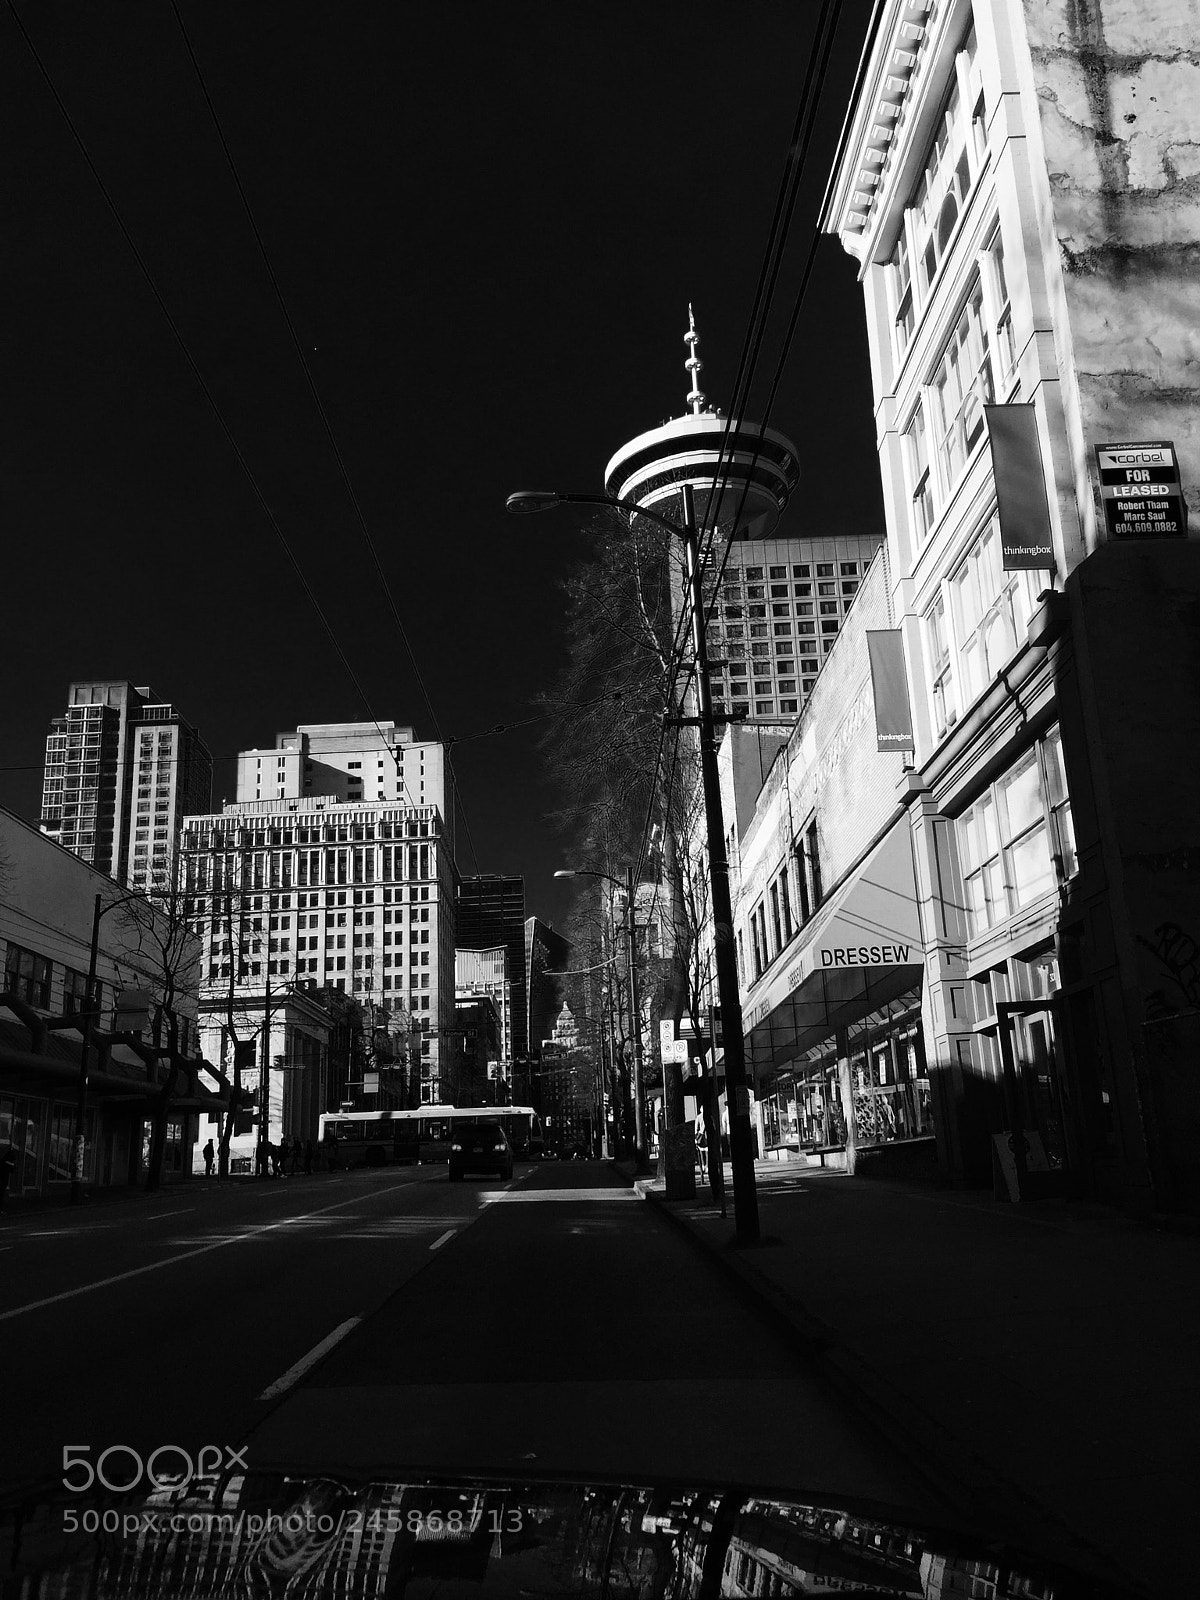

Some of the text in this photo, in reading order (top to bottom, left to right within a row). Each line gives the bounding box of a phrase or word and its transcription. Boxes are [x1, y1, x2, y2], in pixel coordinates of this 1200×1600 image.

[1117, 451, 1165, 463] corbel
[1125, 469, 1151, 482] FOR
[1113, 485, 1169, 497] LEASED
[1117, 500, 1169, 510] Robert Tham
[1123, 511, 1166, 521] Marc Saul
[1115, 521, 1177, 534] 604.609.0882
[1003, 544, 1051, 556] thinkingbox
[877, 733, 912, 742] thinkingbox
[820, 945, 910, 967] DRESSEW
